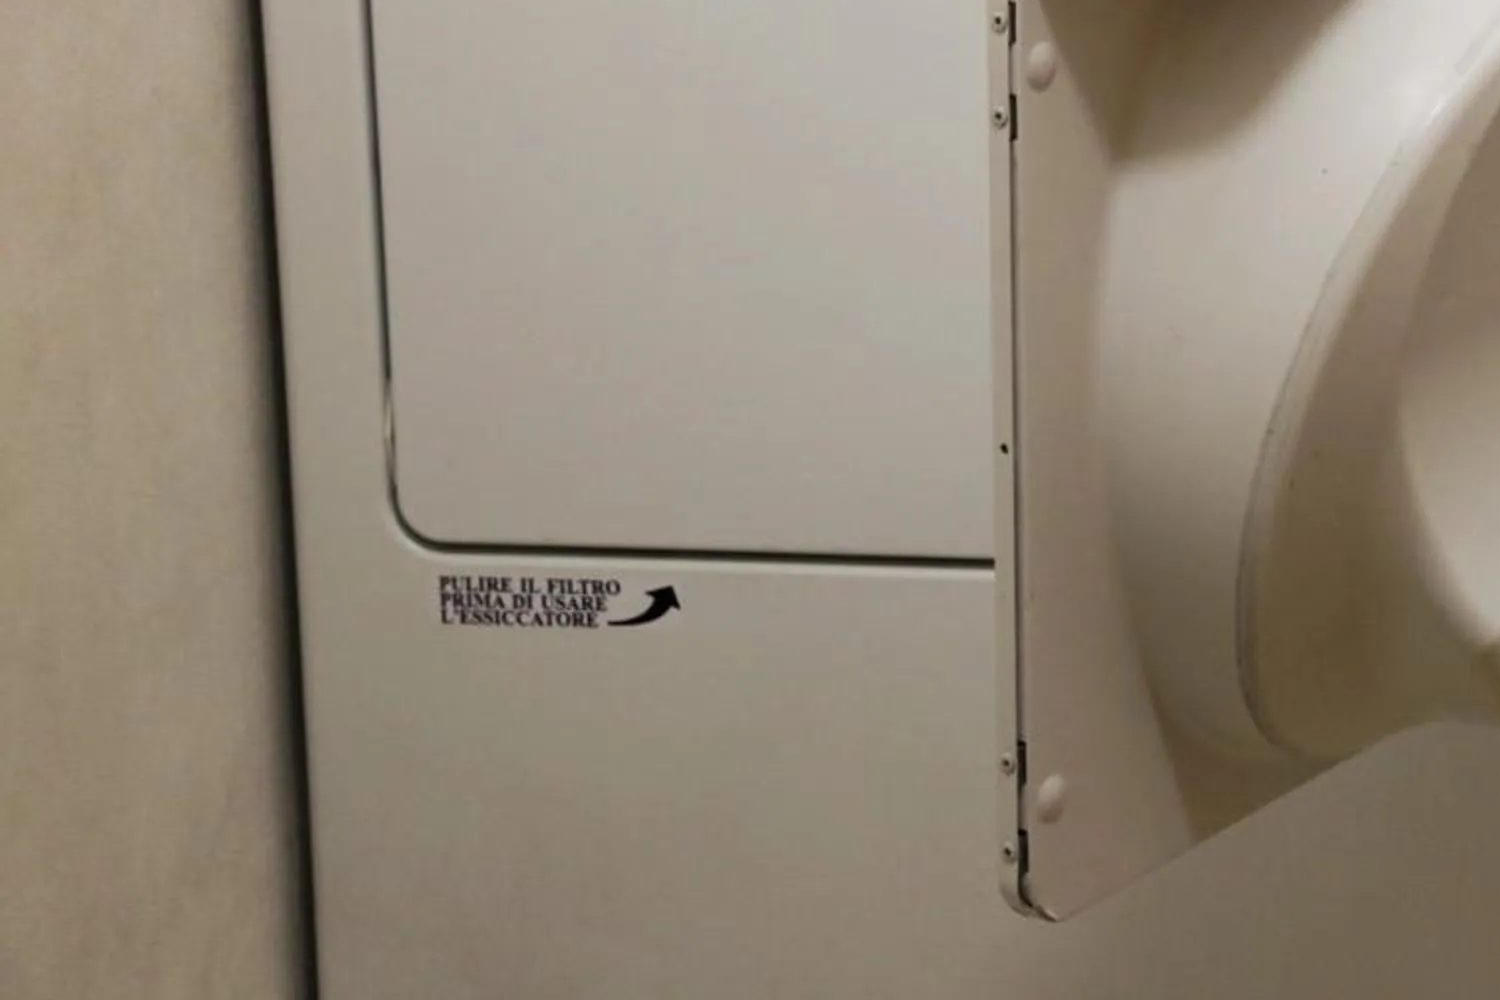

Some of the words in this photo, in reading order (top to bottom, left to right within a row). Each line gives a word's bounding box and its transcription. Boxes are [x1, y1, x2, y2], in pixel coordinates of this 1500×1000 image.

[438, 575, 512, 593] PULIRE
[520, 577, 541, 594] IL
[547, 578, 621, 596] FILTRO
[440, 593, 505, 610] PRIMA
[513, 594, 534, 610] DI
[541, 594, 607, 612] USARE
[440, 609, 600, 628] L'ESSICCATORE
